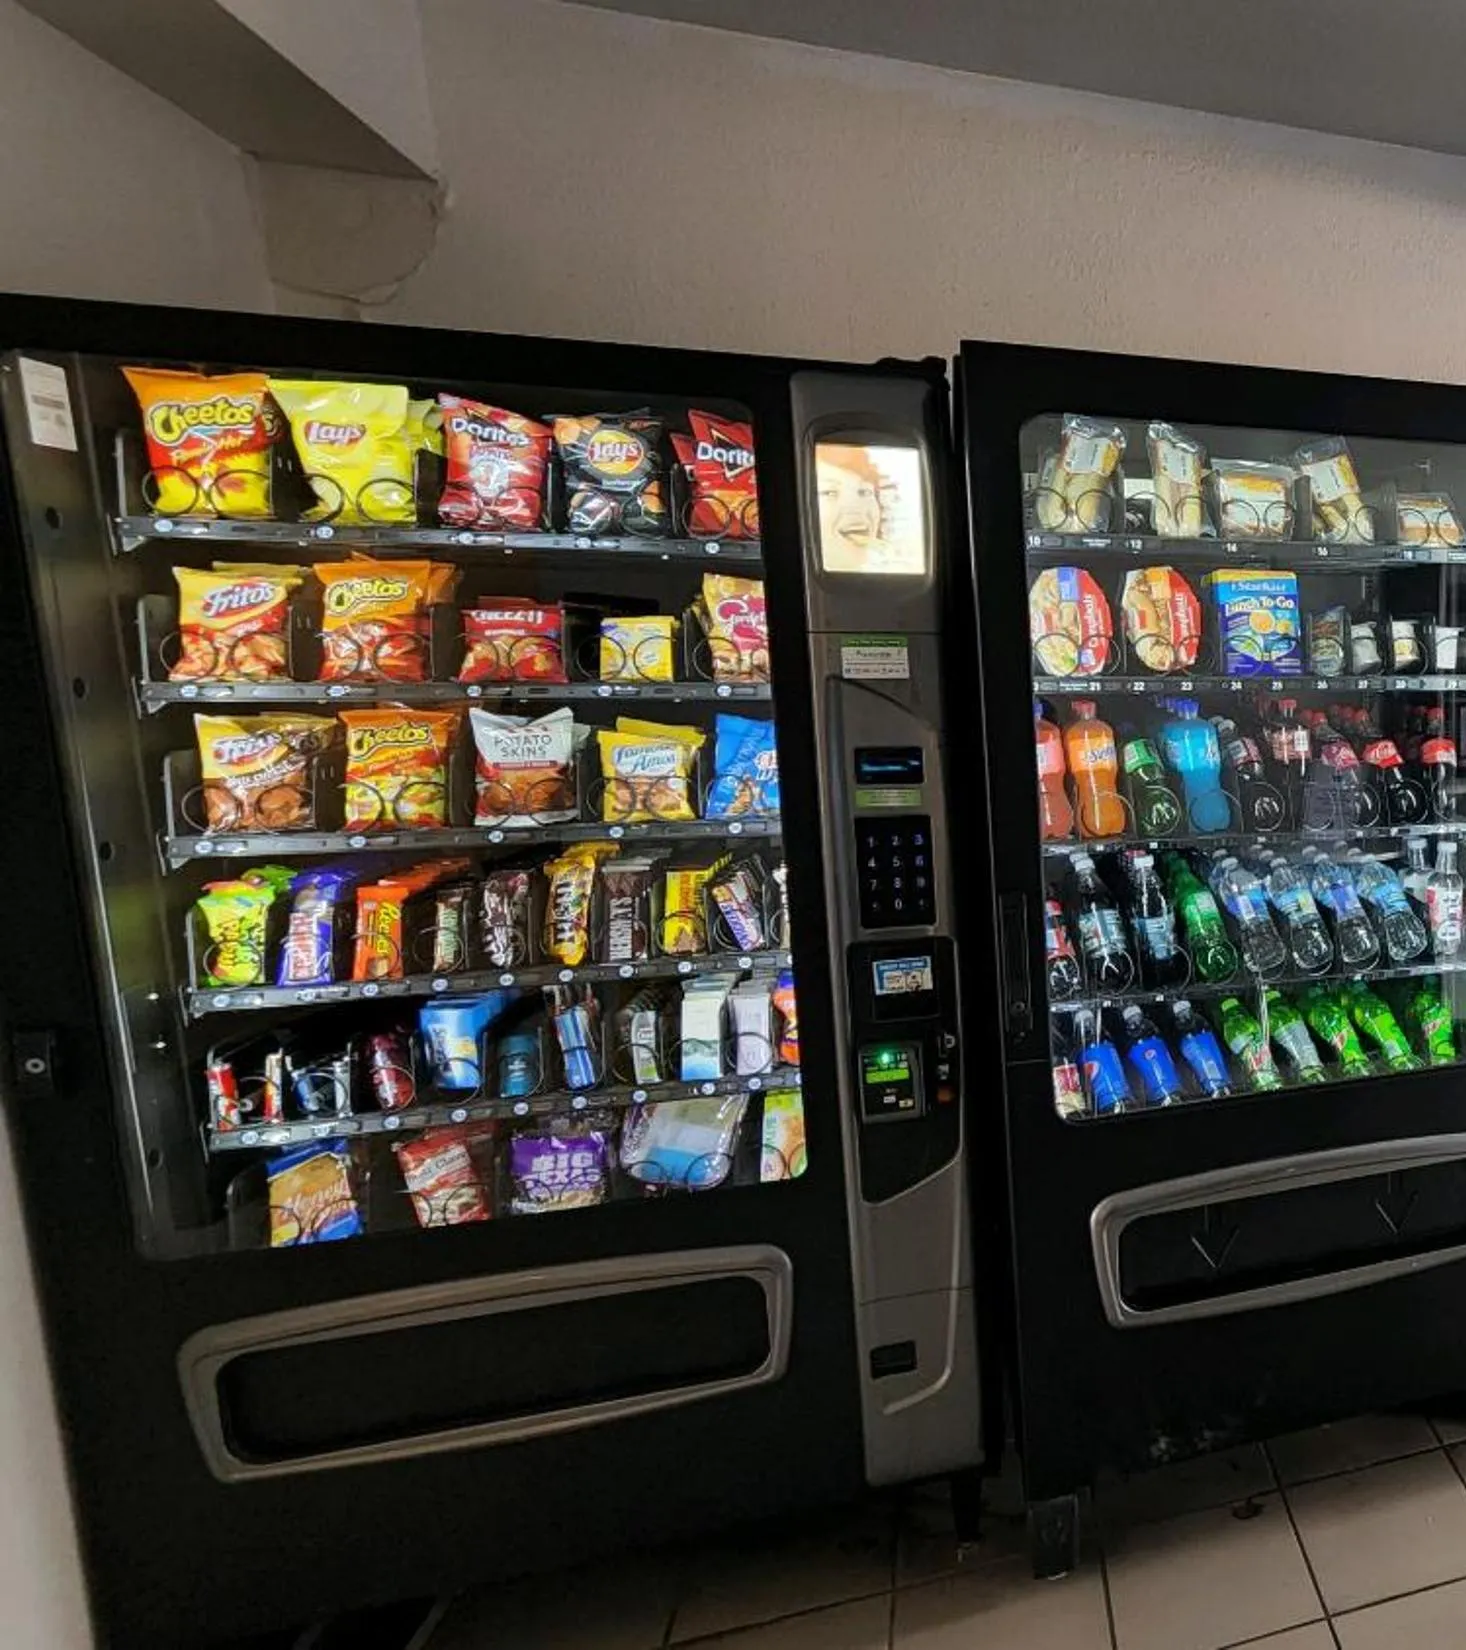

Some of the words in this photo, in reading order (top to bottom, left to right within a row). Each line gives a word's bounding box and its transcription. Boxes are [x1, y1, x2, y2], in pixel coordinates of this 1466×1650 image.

[150, 397, 253, 443] Cheetos
[452, 417, 530, 446] Doritos
[205, 580, 276, 618] Fritos
[328, 579, 407, 612] Cheetos
[1225, 597, 1260, 617] Lunch
[352, 722, 431, 759] Cheetos
[494, 734, 553, 748] POTATO
[500, 745, 548, 758] SKINS
[631, 753, 676, 772] Amos
[531, 1153, 594, 1173] BIG
